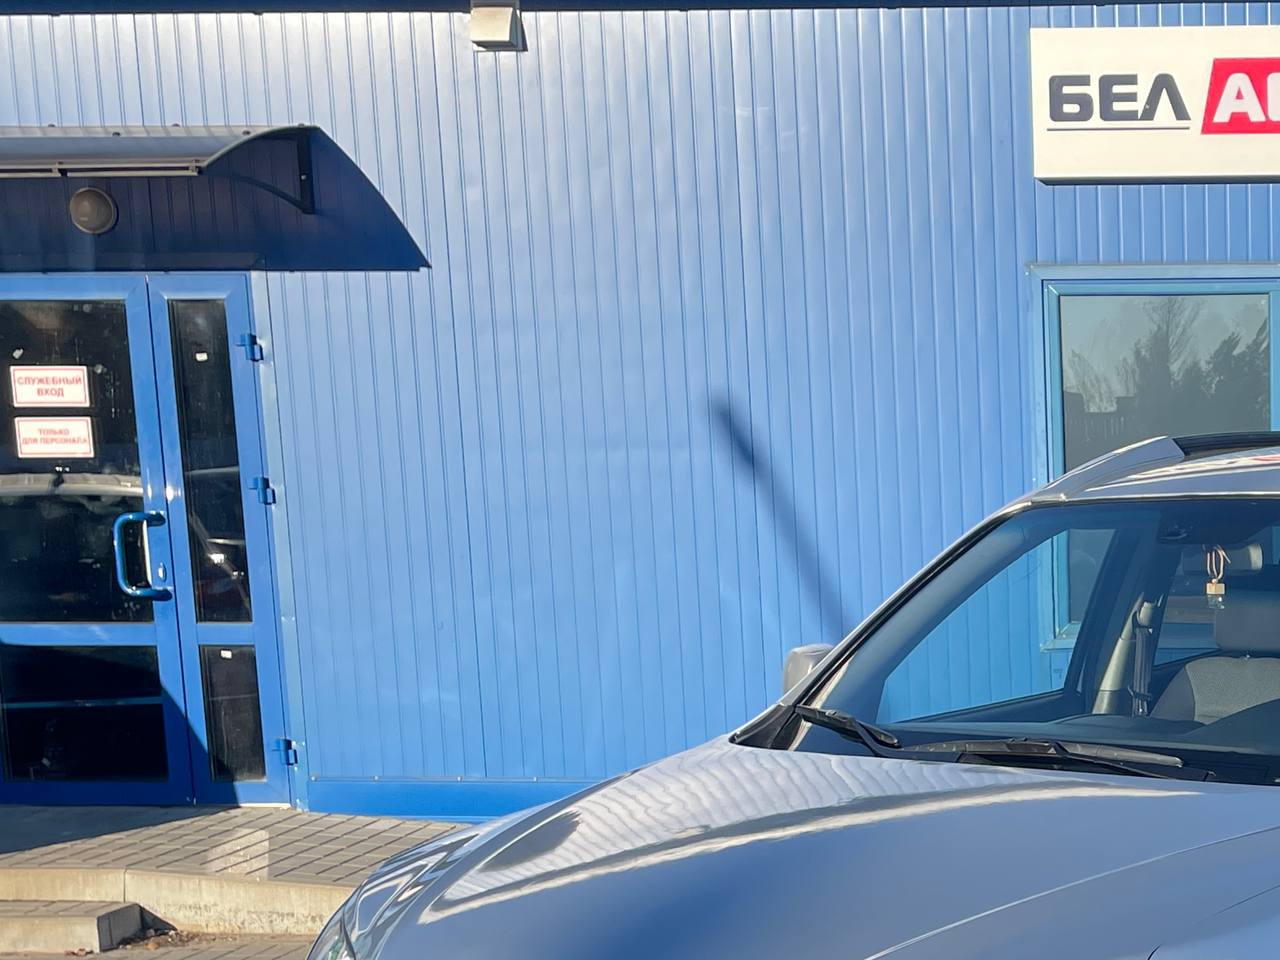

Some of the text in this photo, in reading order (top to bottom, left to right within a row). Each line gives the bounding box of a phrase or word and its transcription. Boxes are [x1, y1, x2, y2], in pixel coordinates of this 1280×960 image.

[1048, 73, 1190, 122] БЕЛ
[17, 375, 82, 385] СЛУЖЕБНЫЙ
[37, 388, 64, 397] ВХОД
[38, 428, 69, 436] ТОЛЬКО
[40, 437, 87, 445] ПЕРСОНАЛА
